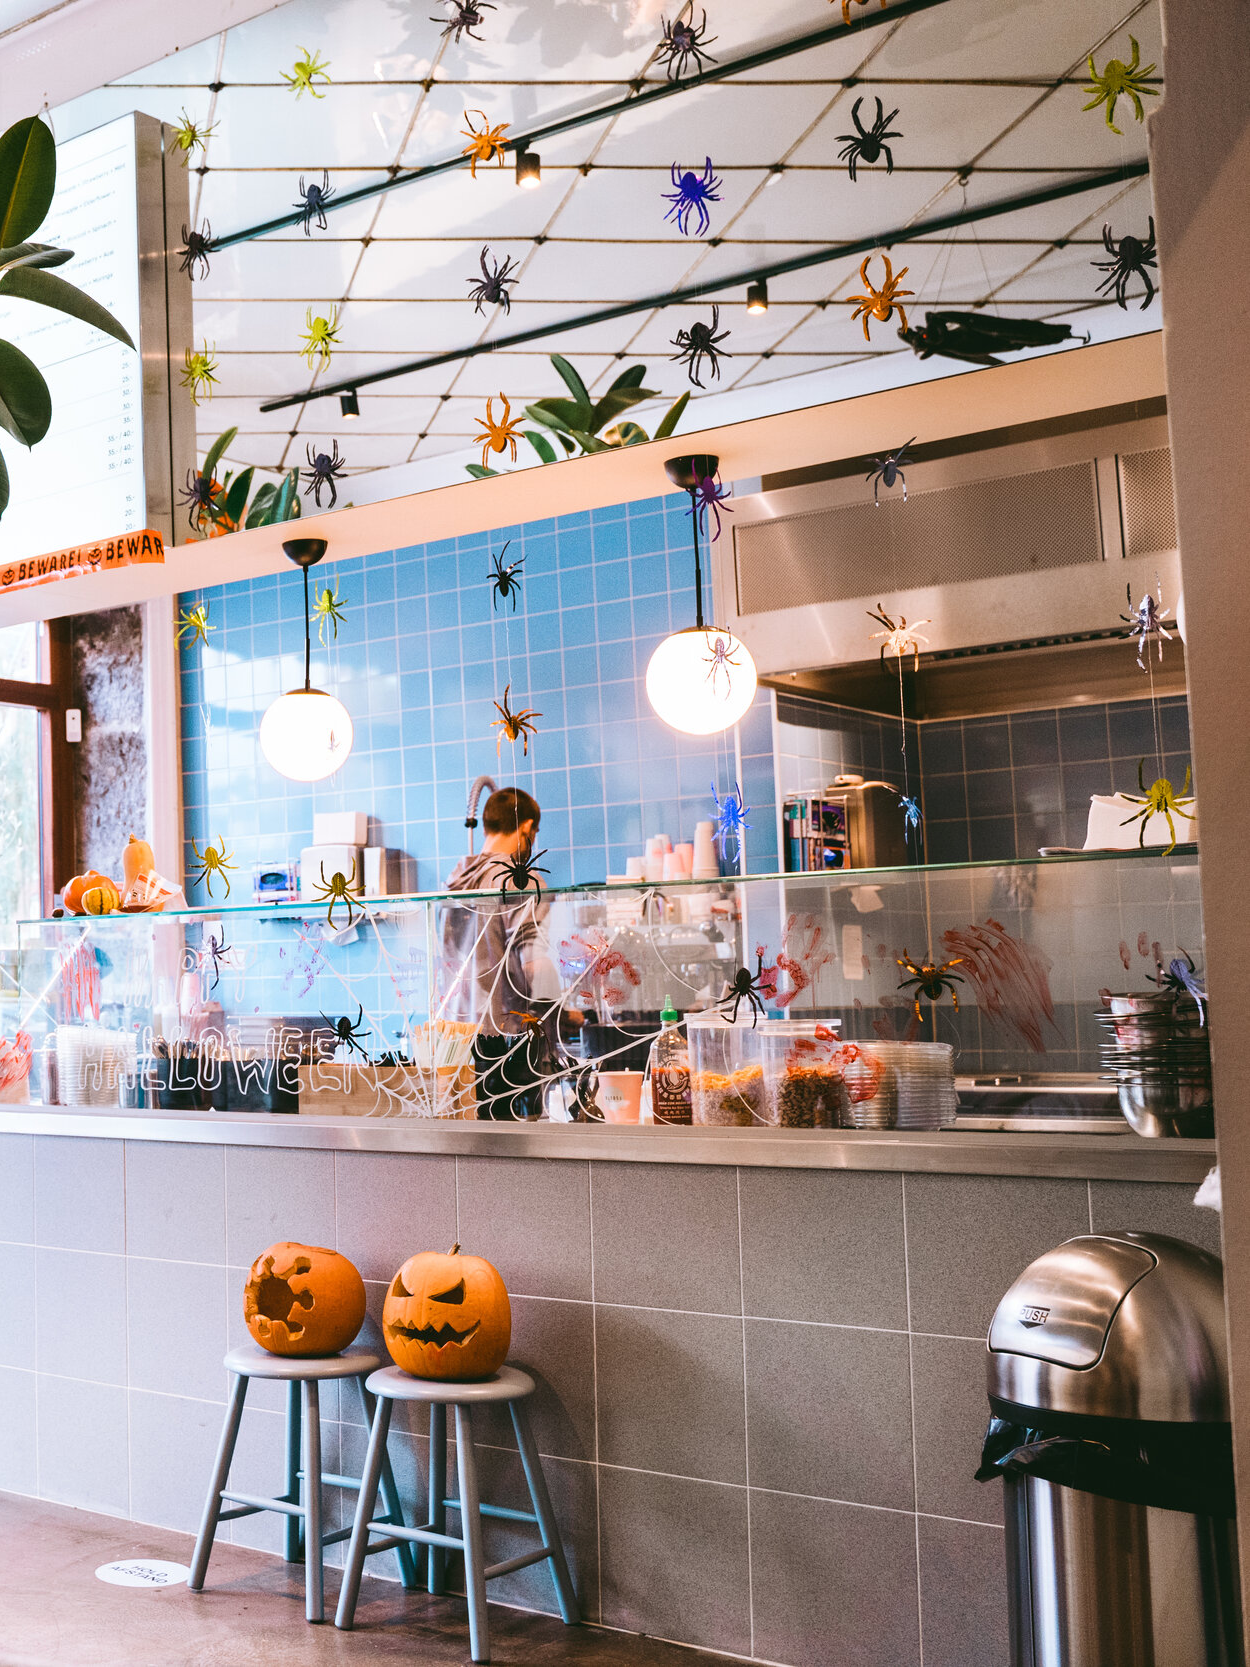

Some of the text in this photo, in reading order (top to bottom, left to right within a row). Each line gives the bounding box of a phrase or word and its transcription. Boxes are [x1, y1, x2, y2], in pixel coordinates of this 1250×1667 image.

[18, 548, 81, 581] BEWARE!
[106, 534, 165, 561] BEWAR
[123, 944, 258, 1008] HPPY
[78, 1022, 380, 1096] HALLOWEEN
[1020, 1309, 1049, 1323] PUSH
[110, 1566, 168, 1583] AFSTAND
[131, 1565, 168, 1577] HOLD
